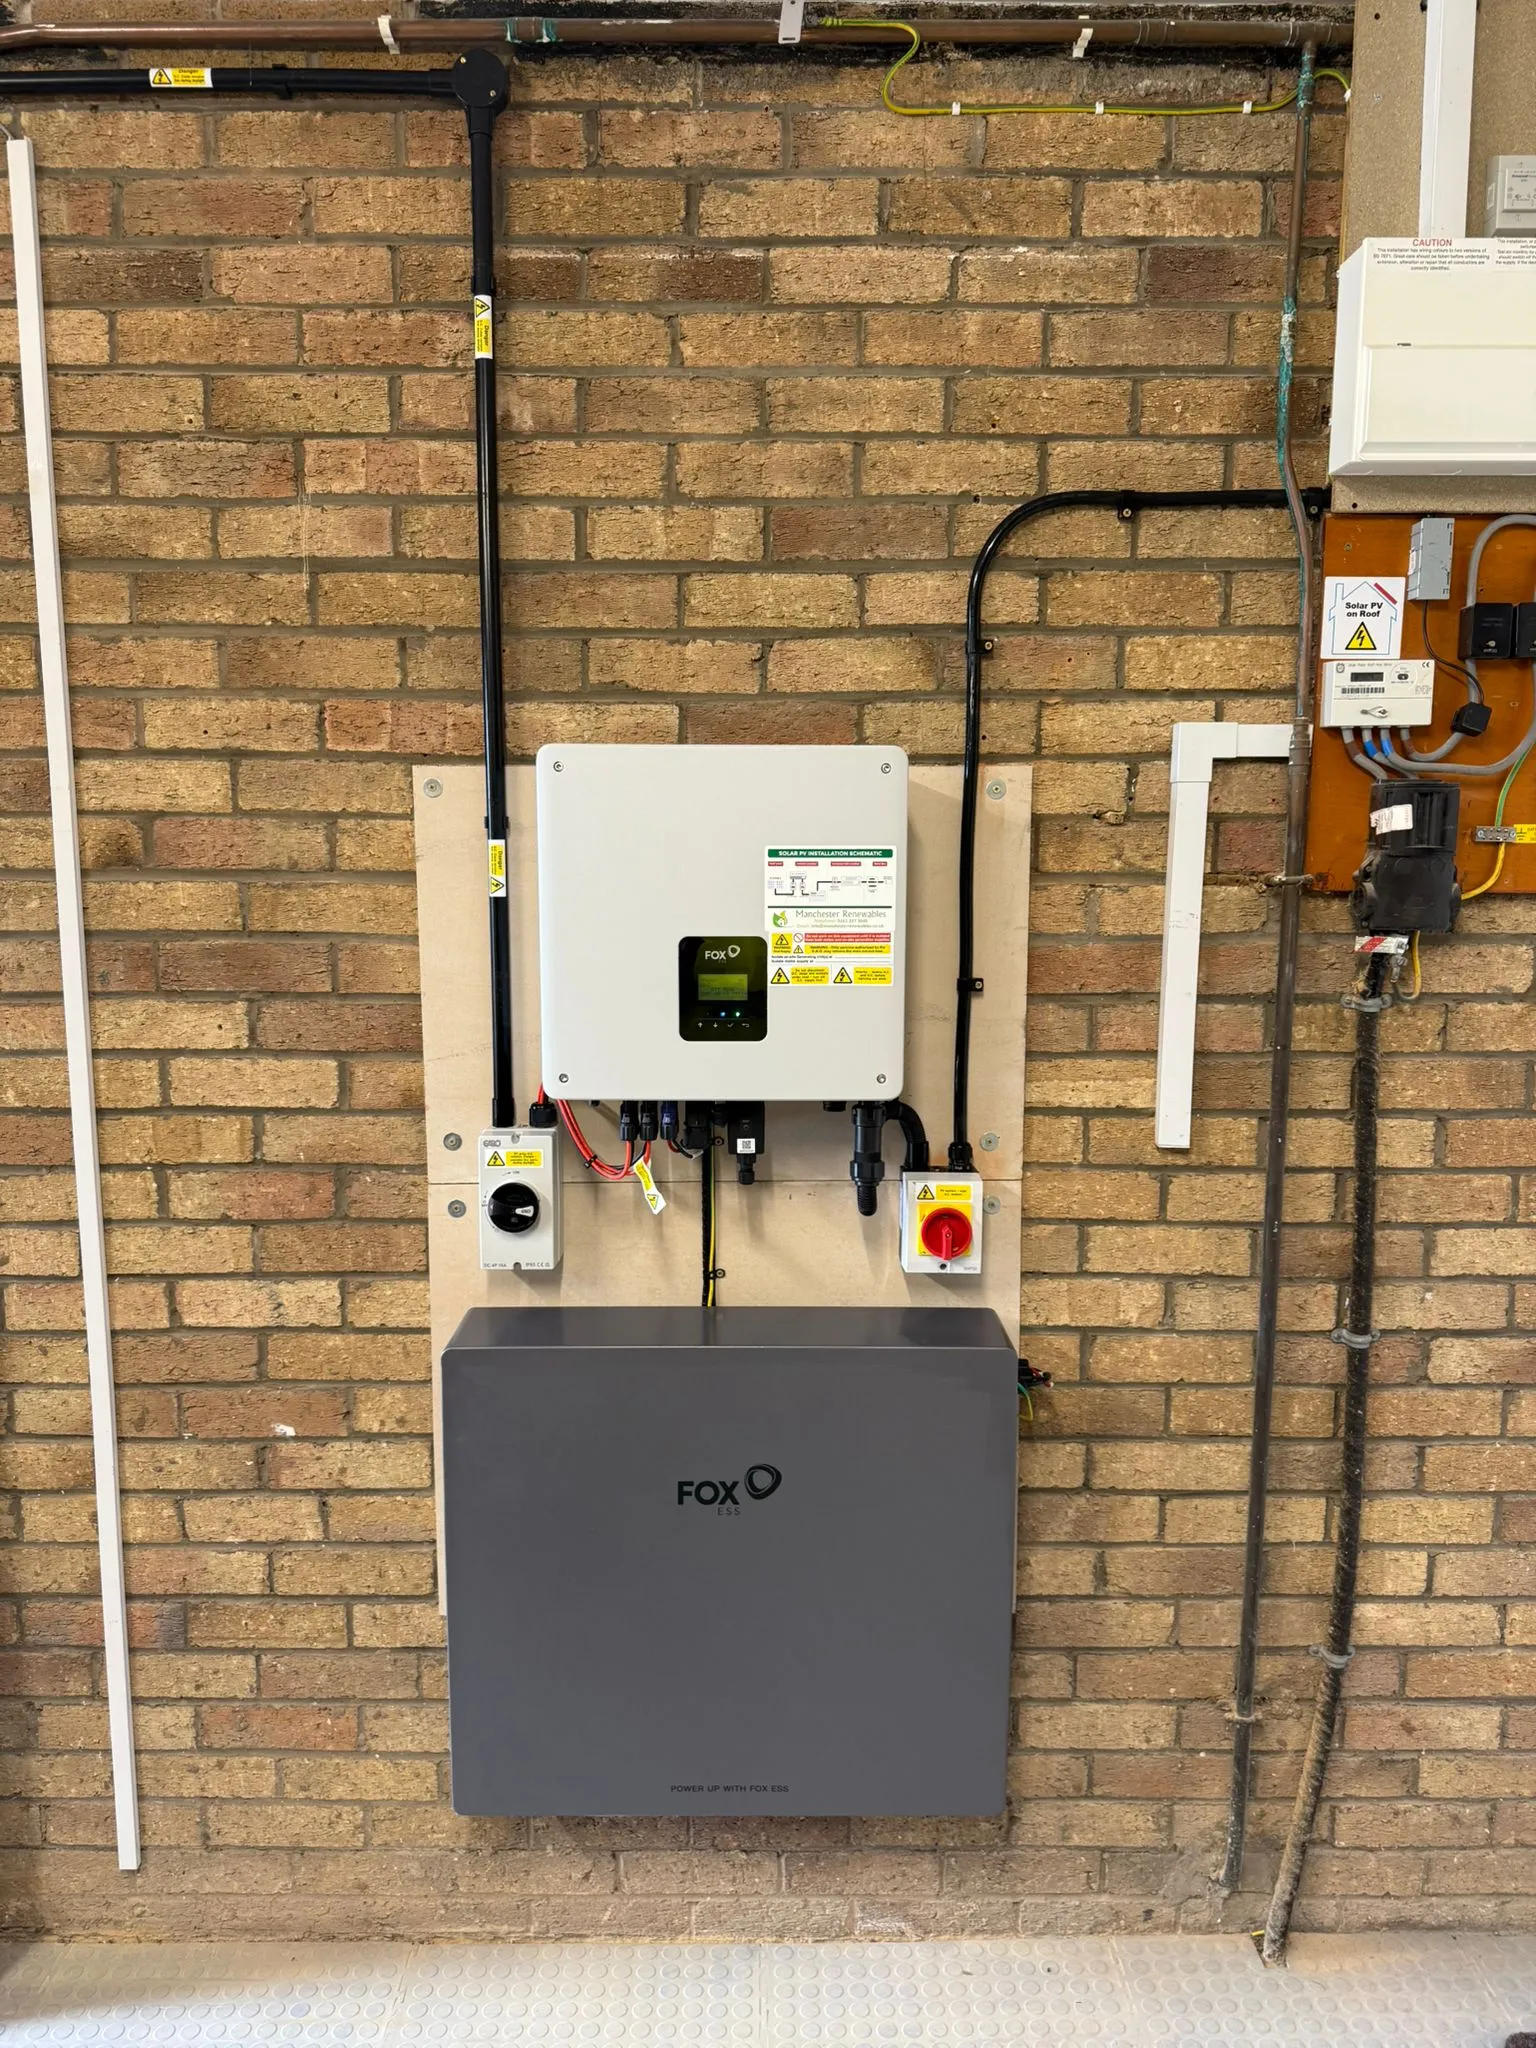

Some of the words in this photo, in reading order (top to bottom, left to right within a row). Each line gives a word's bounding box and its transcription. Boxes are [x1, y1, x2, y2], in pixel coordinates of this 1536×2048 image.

[1412, 238, 1452, 246] CAUTION
[796, 910, 840, 918] Manchester
[842, 910, 886, 918] Renewables
[705, 951, 726, 960] FOX
[678, 1481, 739, 1505] FOX
[718, 1507, 740, 1516] ESS
